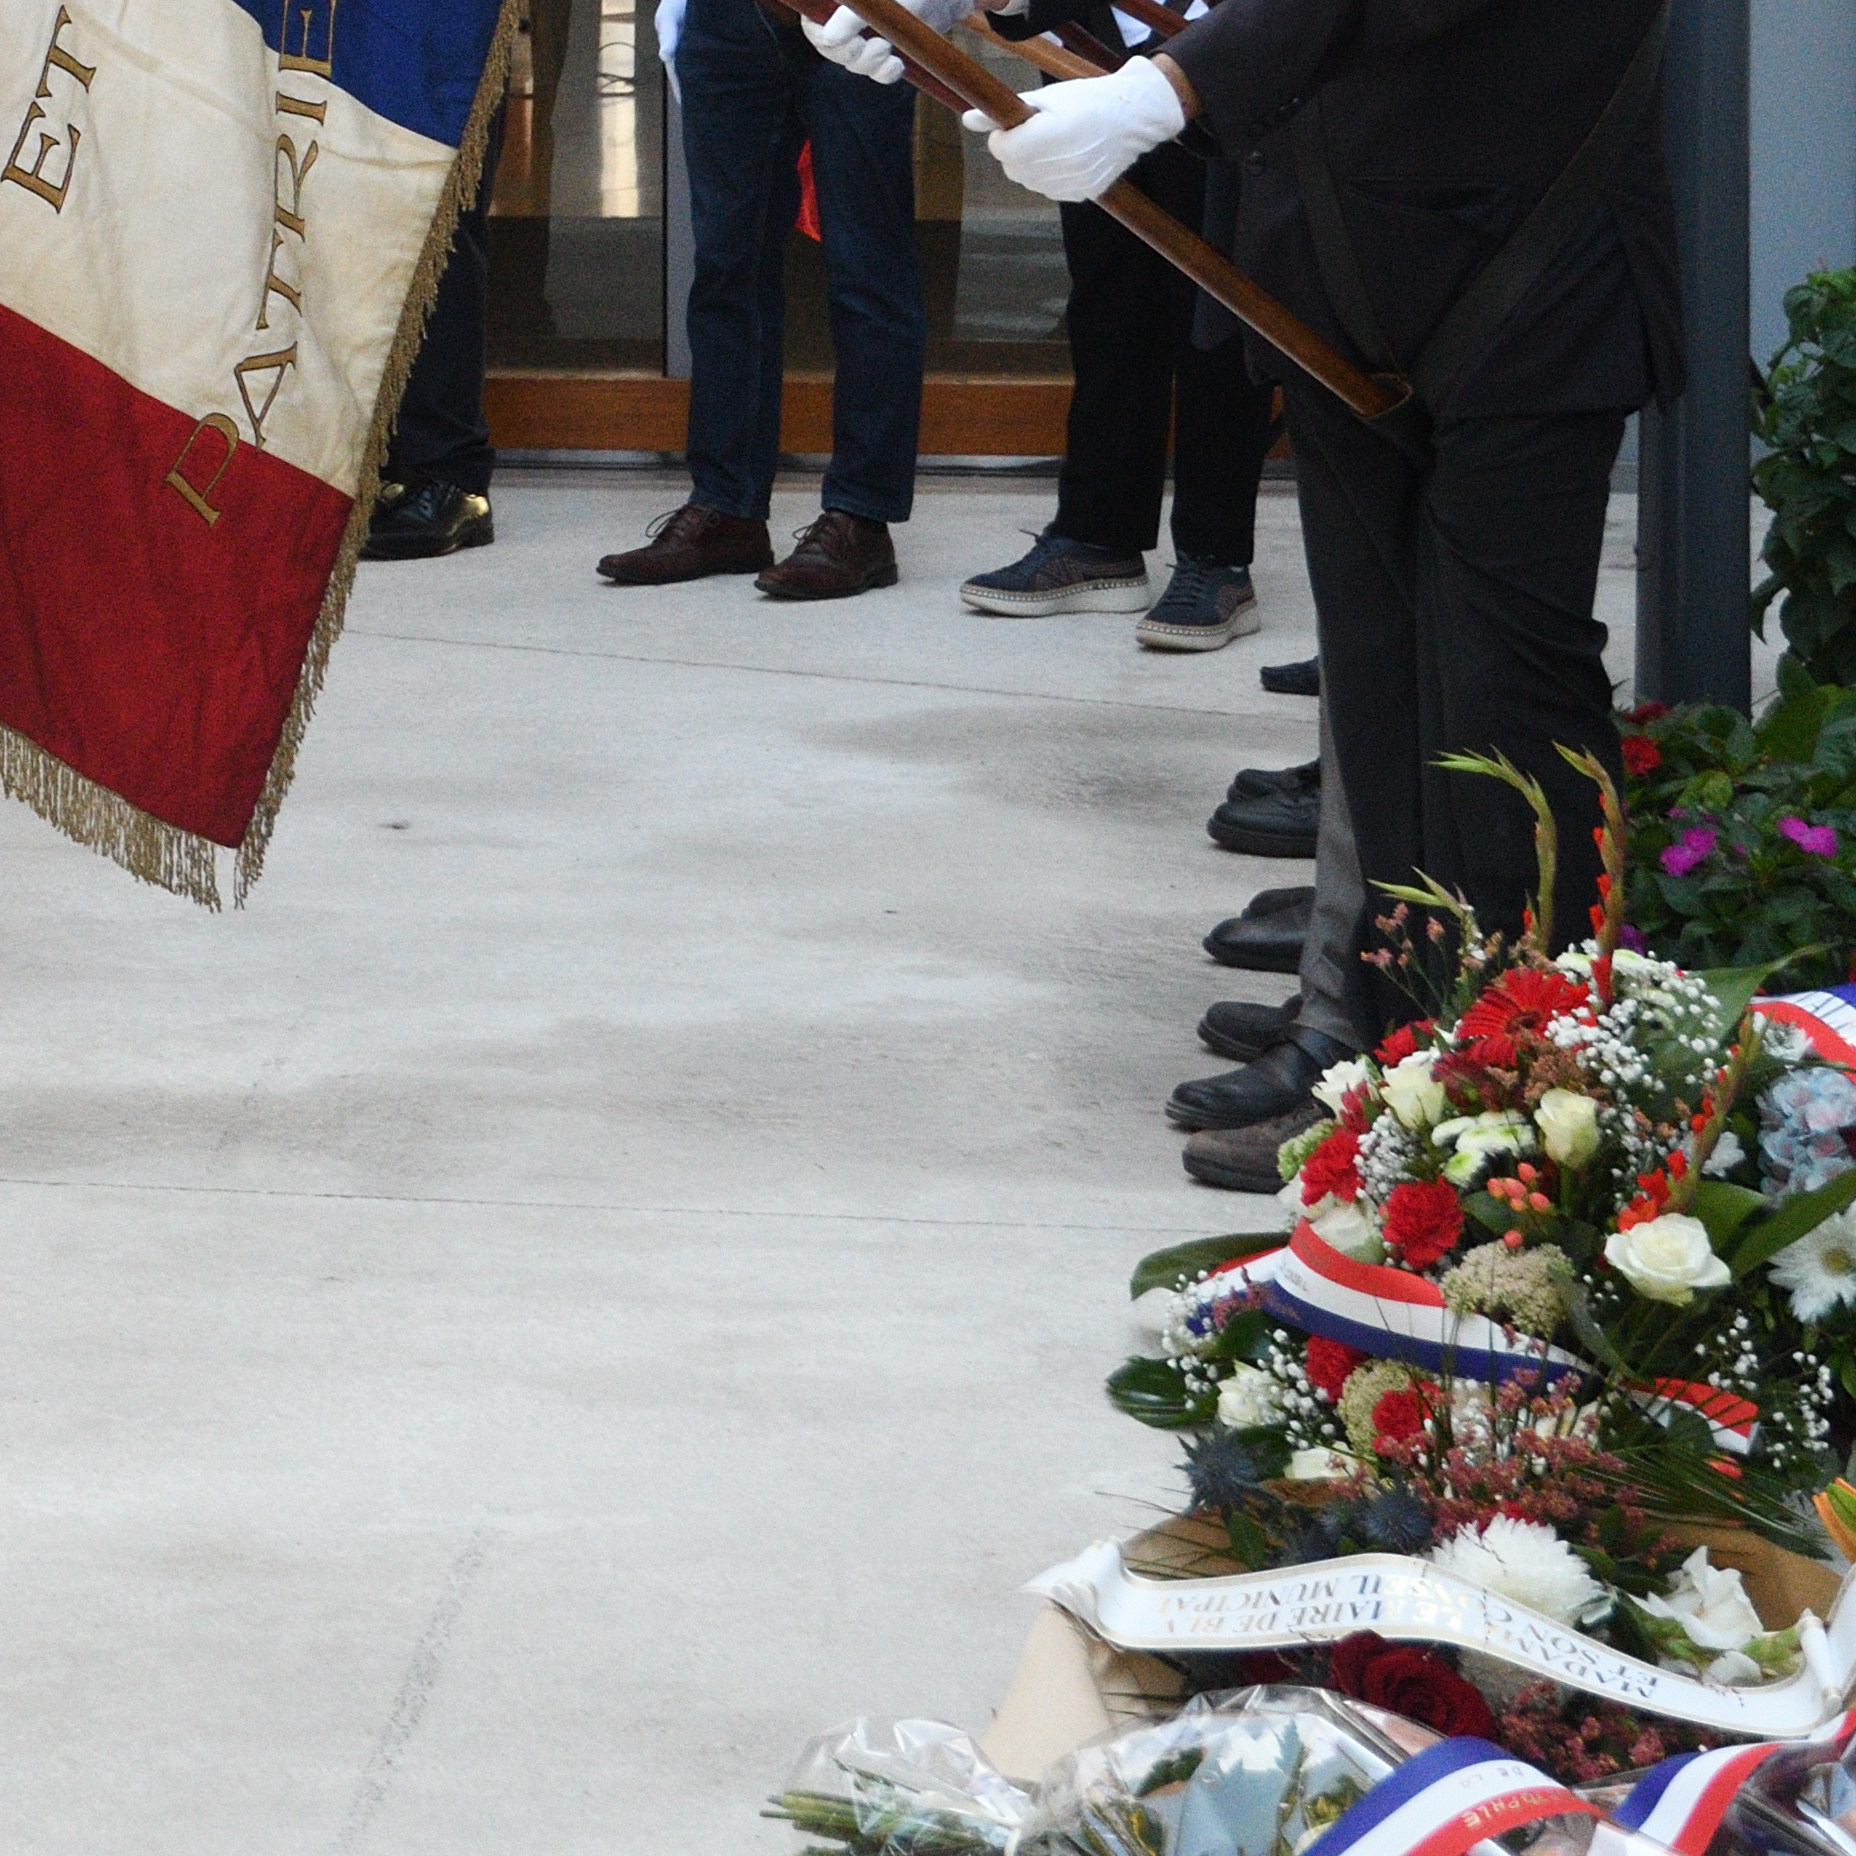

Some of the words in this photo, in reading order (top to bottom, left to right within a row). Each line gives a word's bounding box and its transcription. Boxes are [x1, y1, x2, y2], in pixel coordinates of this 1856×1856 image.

[0, 6, 97, 214] ET
[1233, 1611, 1278, 1633] DE
[1522, 1624, 1599, 1666] SON
[1608, 1664, 1658, 1688] ET
